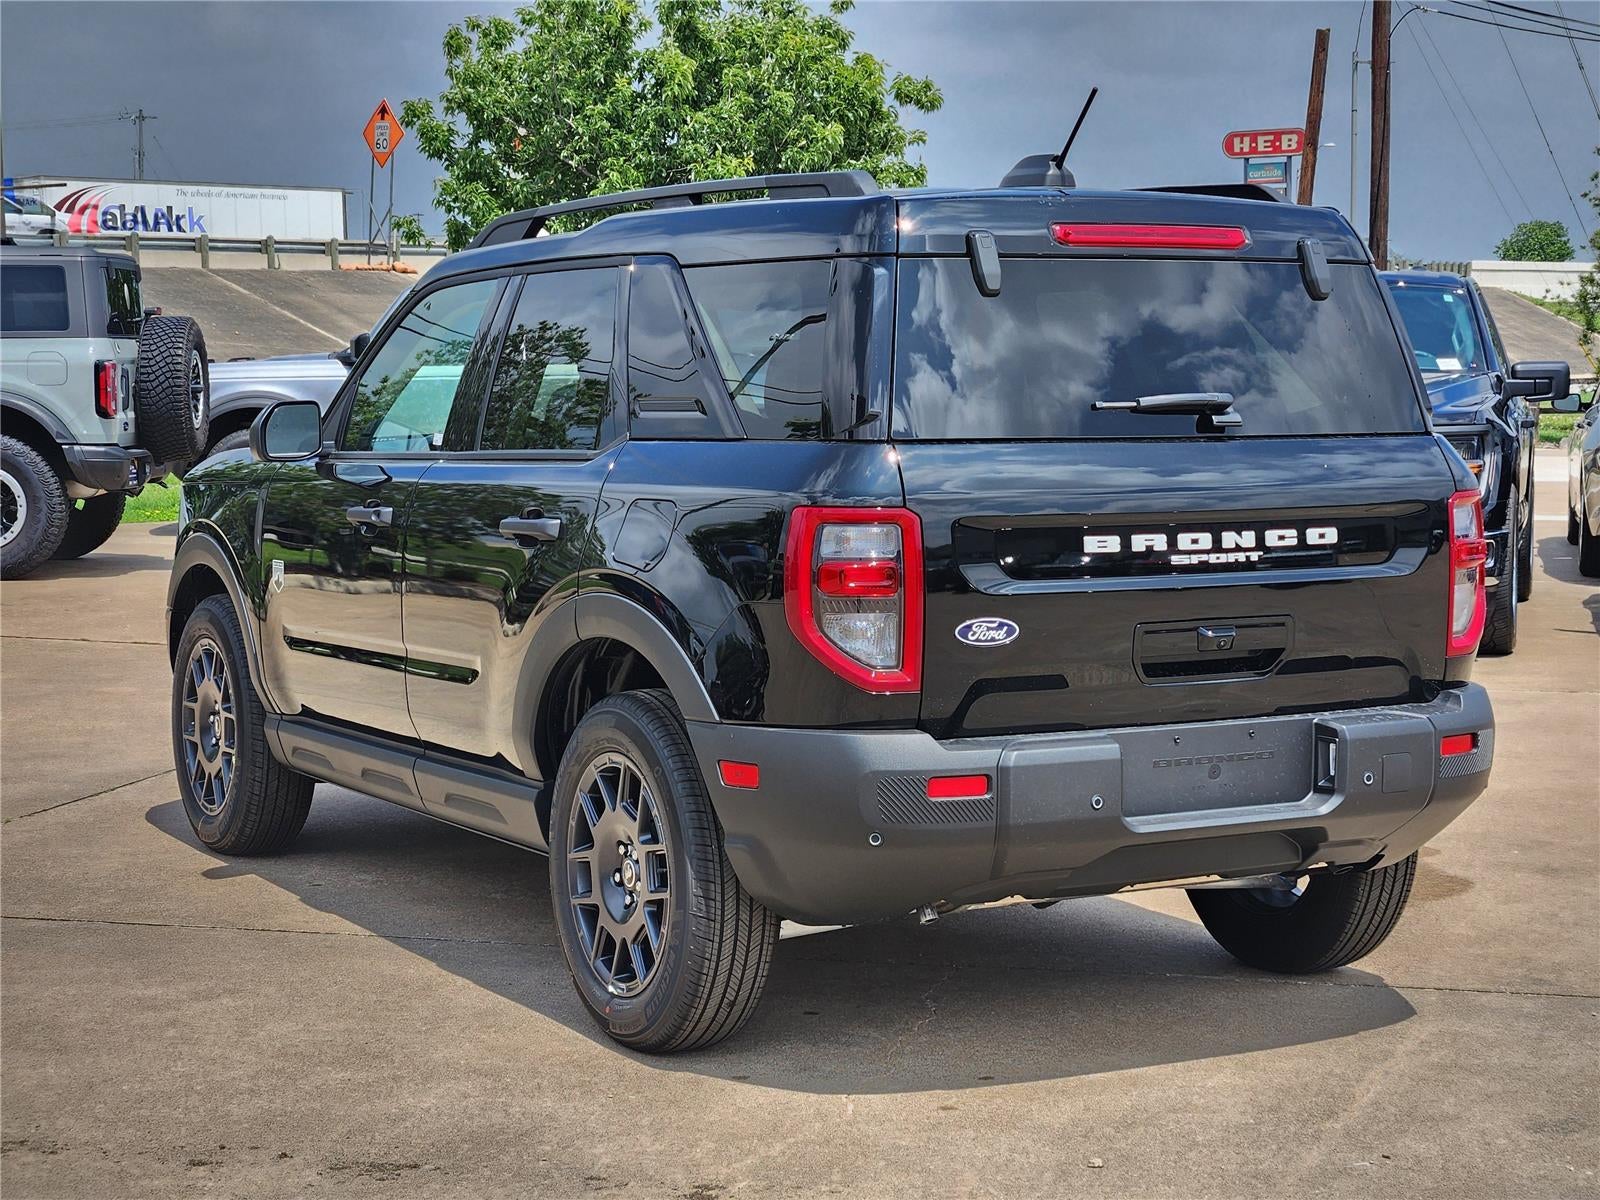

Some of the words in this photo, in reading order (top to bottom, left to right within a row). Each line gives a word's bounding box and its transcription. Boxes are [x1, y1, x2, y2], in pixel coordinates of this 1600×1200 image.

[375, 138, 388, 150] 60
[1249, 168, 1282, 178] curbside
[176, 188, 188, 198] The
[190, 189, 214, 199] wheels
[215, 190, 224, 199] of
[224, 190, 258, 200] American
[1083, 526, 1339, 554] BRONCO
[1170, 551, 1264, 565] SPORT
[967, 620, 1008, 641] Ford
[1152, 750, 1276, 769] BRONCO
